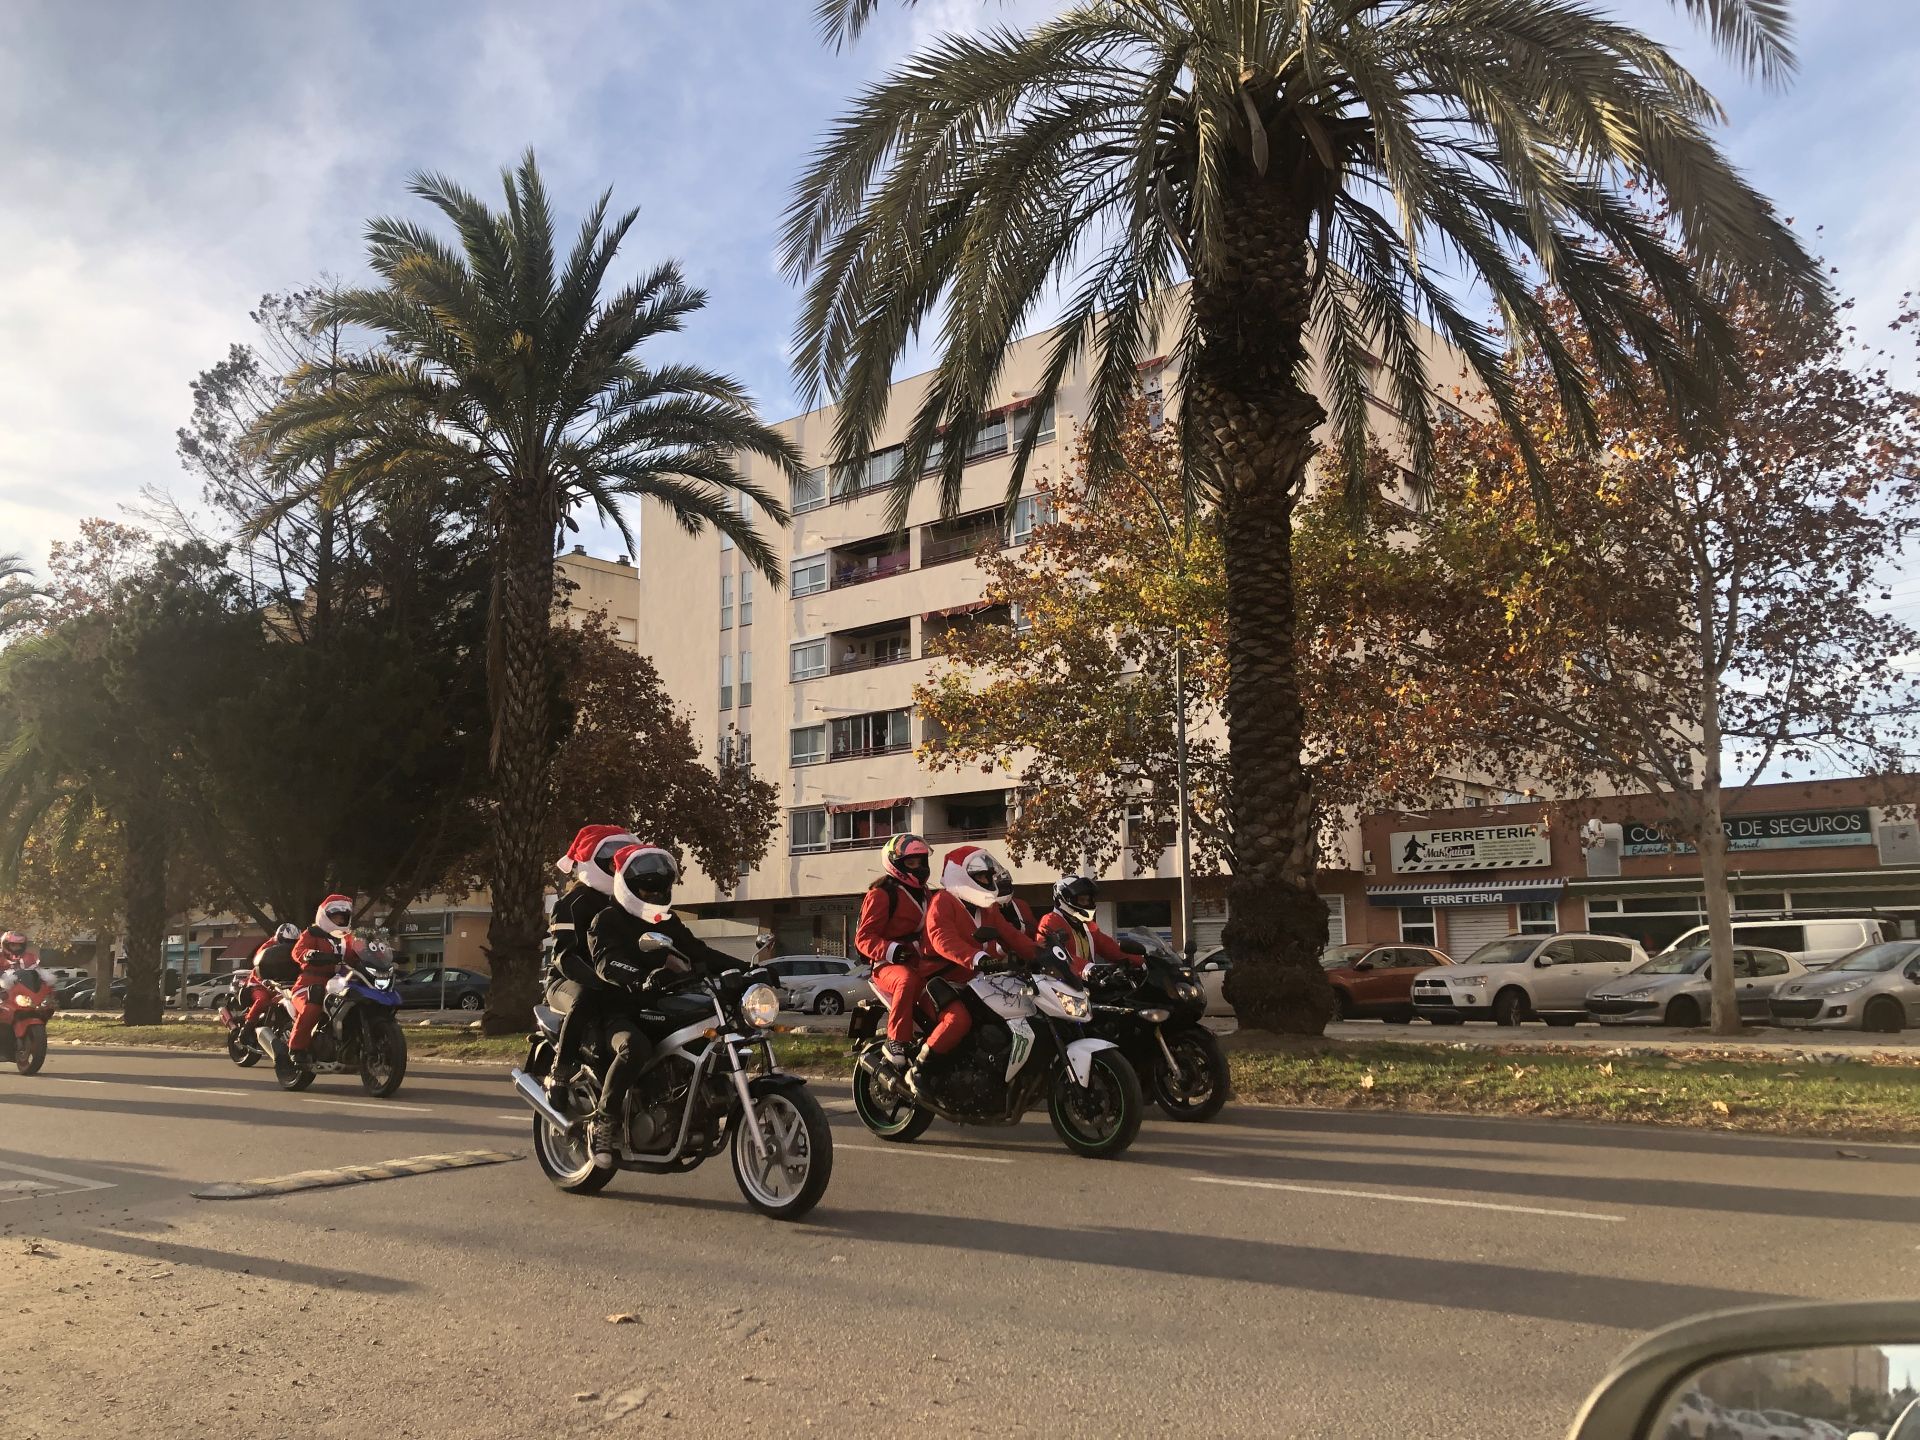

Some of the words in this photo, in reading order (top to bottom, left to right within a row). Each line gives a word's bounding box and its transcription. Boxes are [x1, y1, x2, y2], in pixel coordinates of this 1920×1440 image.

[1431, 827, 1536, 843] FERRETERIA
[1631, 822, 1733, 842] CORR
[1739, 820, 1763, 836] DE
[1769, 815, 1861, 835] SEGUROS
[1422, 893, 1503, 905] FERRETERIA
